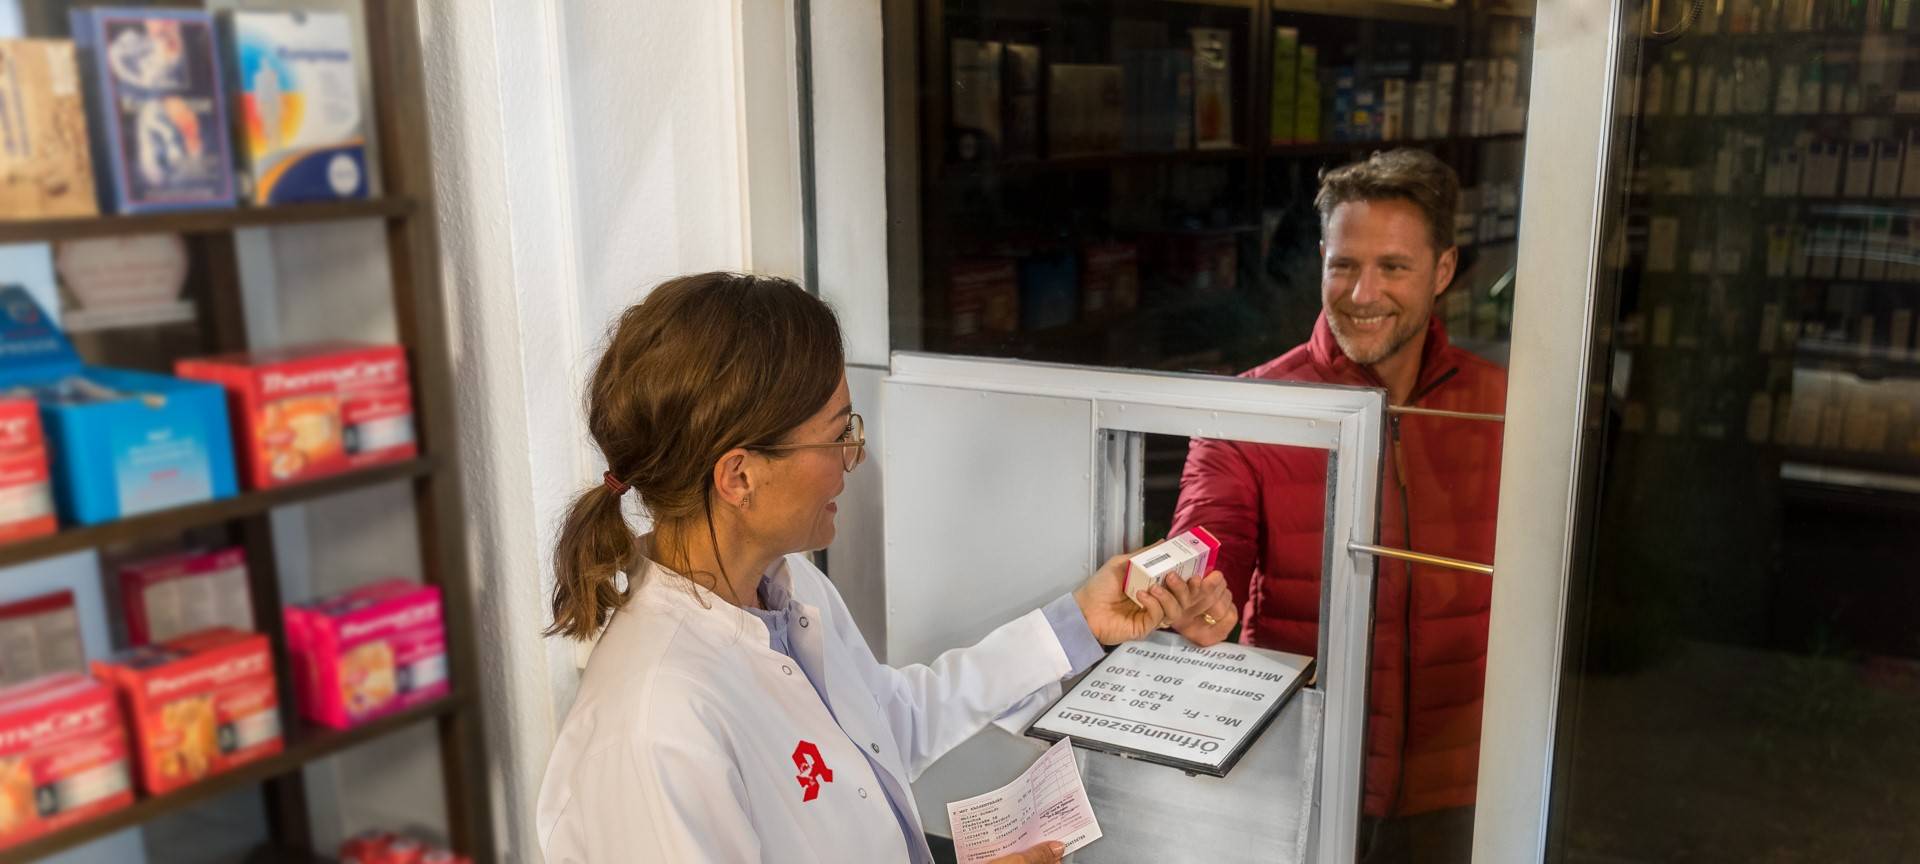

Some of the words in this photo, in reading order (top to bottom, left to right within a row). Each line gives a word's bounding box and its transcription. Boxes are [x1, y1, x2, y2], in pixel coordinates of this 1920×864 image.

[1180, 645, 1248, 662] geöffnet
[1105, 664, 1142, 678] 13.00
[1125, 645, 1285, 683] Mittwochnachmittag
[1089, 679, 1126, 694] 18.30
[1152, 673, 1185, 687] 9.00
[1079, 688, 1117, 703] 13.00
[1138, 688, 1175, 703] 14.30
[1197, 680, 1266, 702] Samstag
[1128, 698, 1162, 712] 8.30
[1181, 707, 1201, 719] Fr.
[1214, 714, 1243, 728] Mo.
[1058, 710, 1220, 755] Öffnungszeiten
